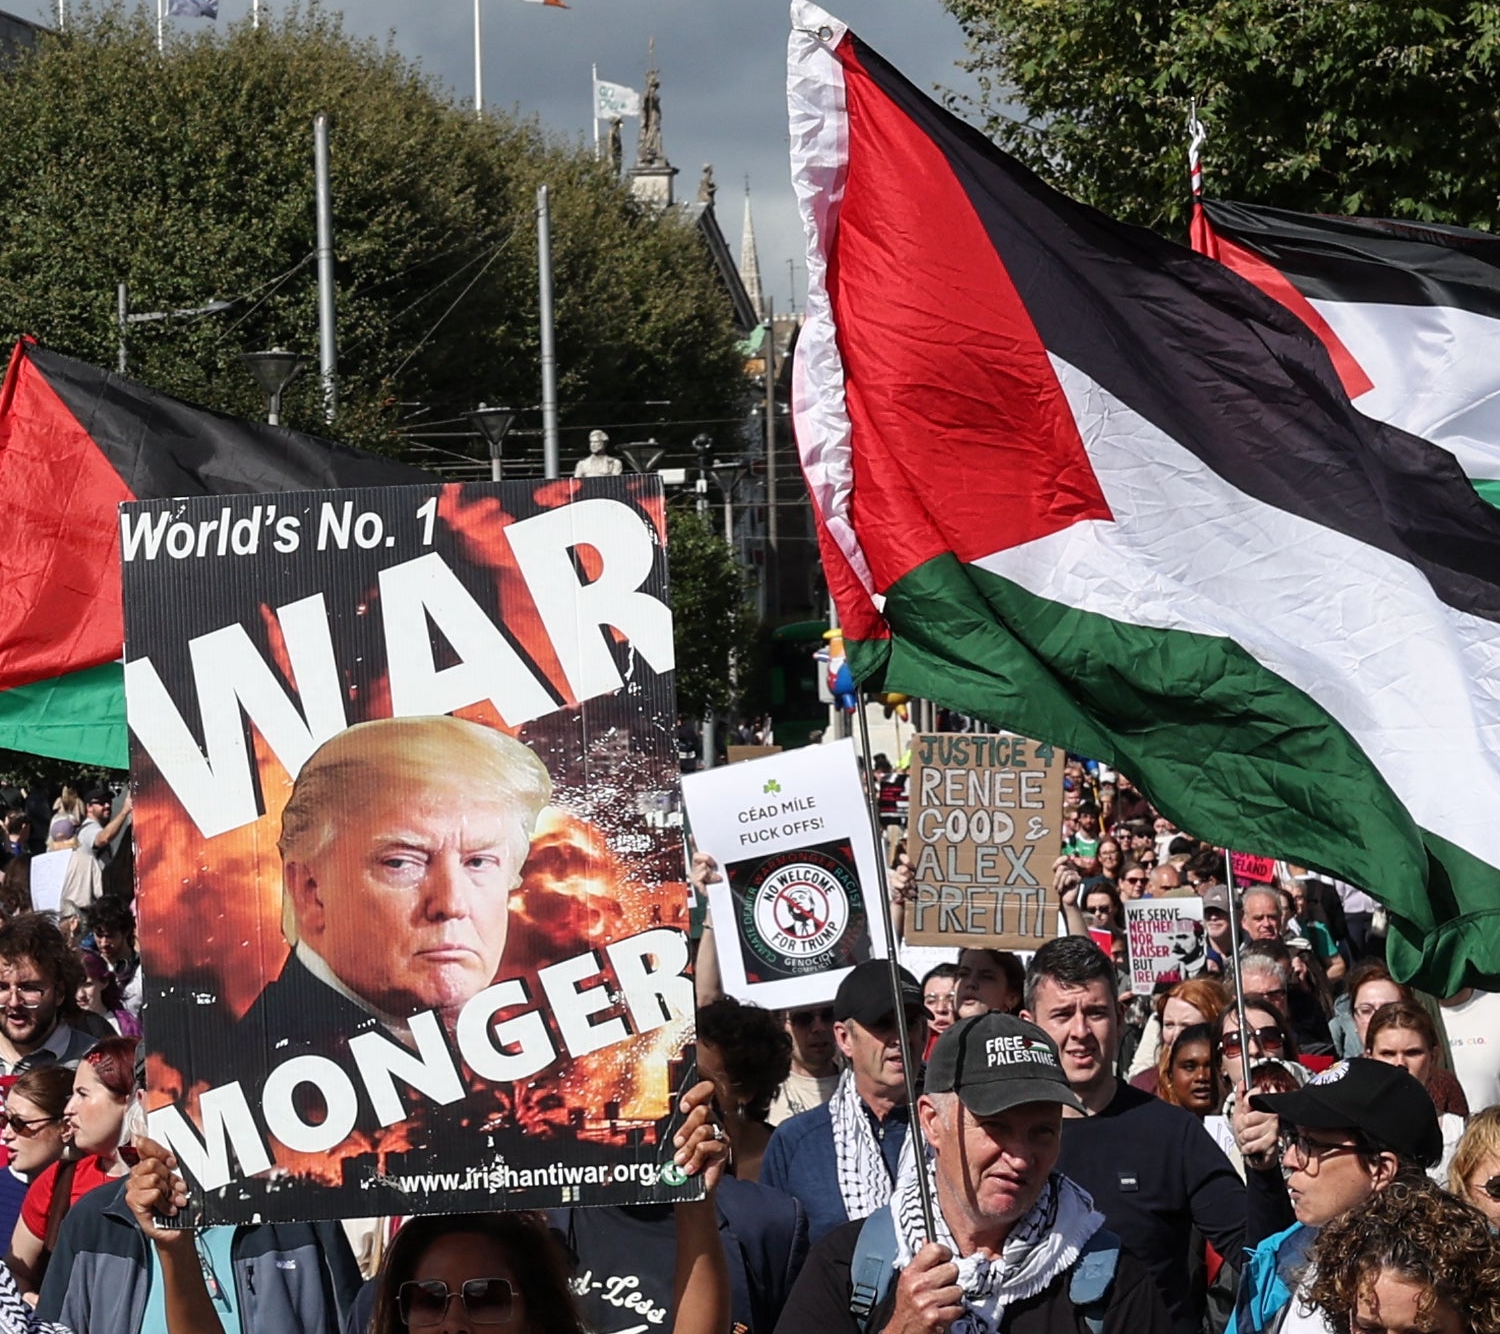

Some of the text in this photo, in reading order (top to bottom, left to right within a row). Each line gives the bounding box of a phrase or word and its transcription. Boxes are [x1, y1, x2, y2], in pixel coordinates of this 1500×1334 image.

[119, 496, 439, 562] World's No. 1
[126, 497, 676, 840] WAR
[918, 735, 1056, 768] JUSTICE 4
[920, 766, 1047, 809] RENÉE
[737, 796, 817, 824] CÉAD MÍLE
[917, 807, 1015, 845] GOOD
[739, 817, 825, 845] FUCK OFFS!
[914, 844, 1040, 886] ALEX
[762, 869, 836, 903] NO WELCOME
[834, 867, 862, 908] RACIST
[913, 883, 1047, 939] PRETTI
[1127, 907, 1180, 921] WE SERVE
[1129, 920, 1173, 934] NEITHER
[771, 930, 796, 952] FOR
[800, 920, 839, 952] TRUMP
[1130, 934, 1153, 946] NOR
[1131, 945, 1170, 958] KAISER
[784, 950, 836, 967] GENOCIDE
[1133, 958, 1153, 970] BUT
[146, 926, 697, 1193] MONGER
[985, 1035, 1025, 1054] FREE
[399, 1158, 655, 1196] www.irishantiwar.org
